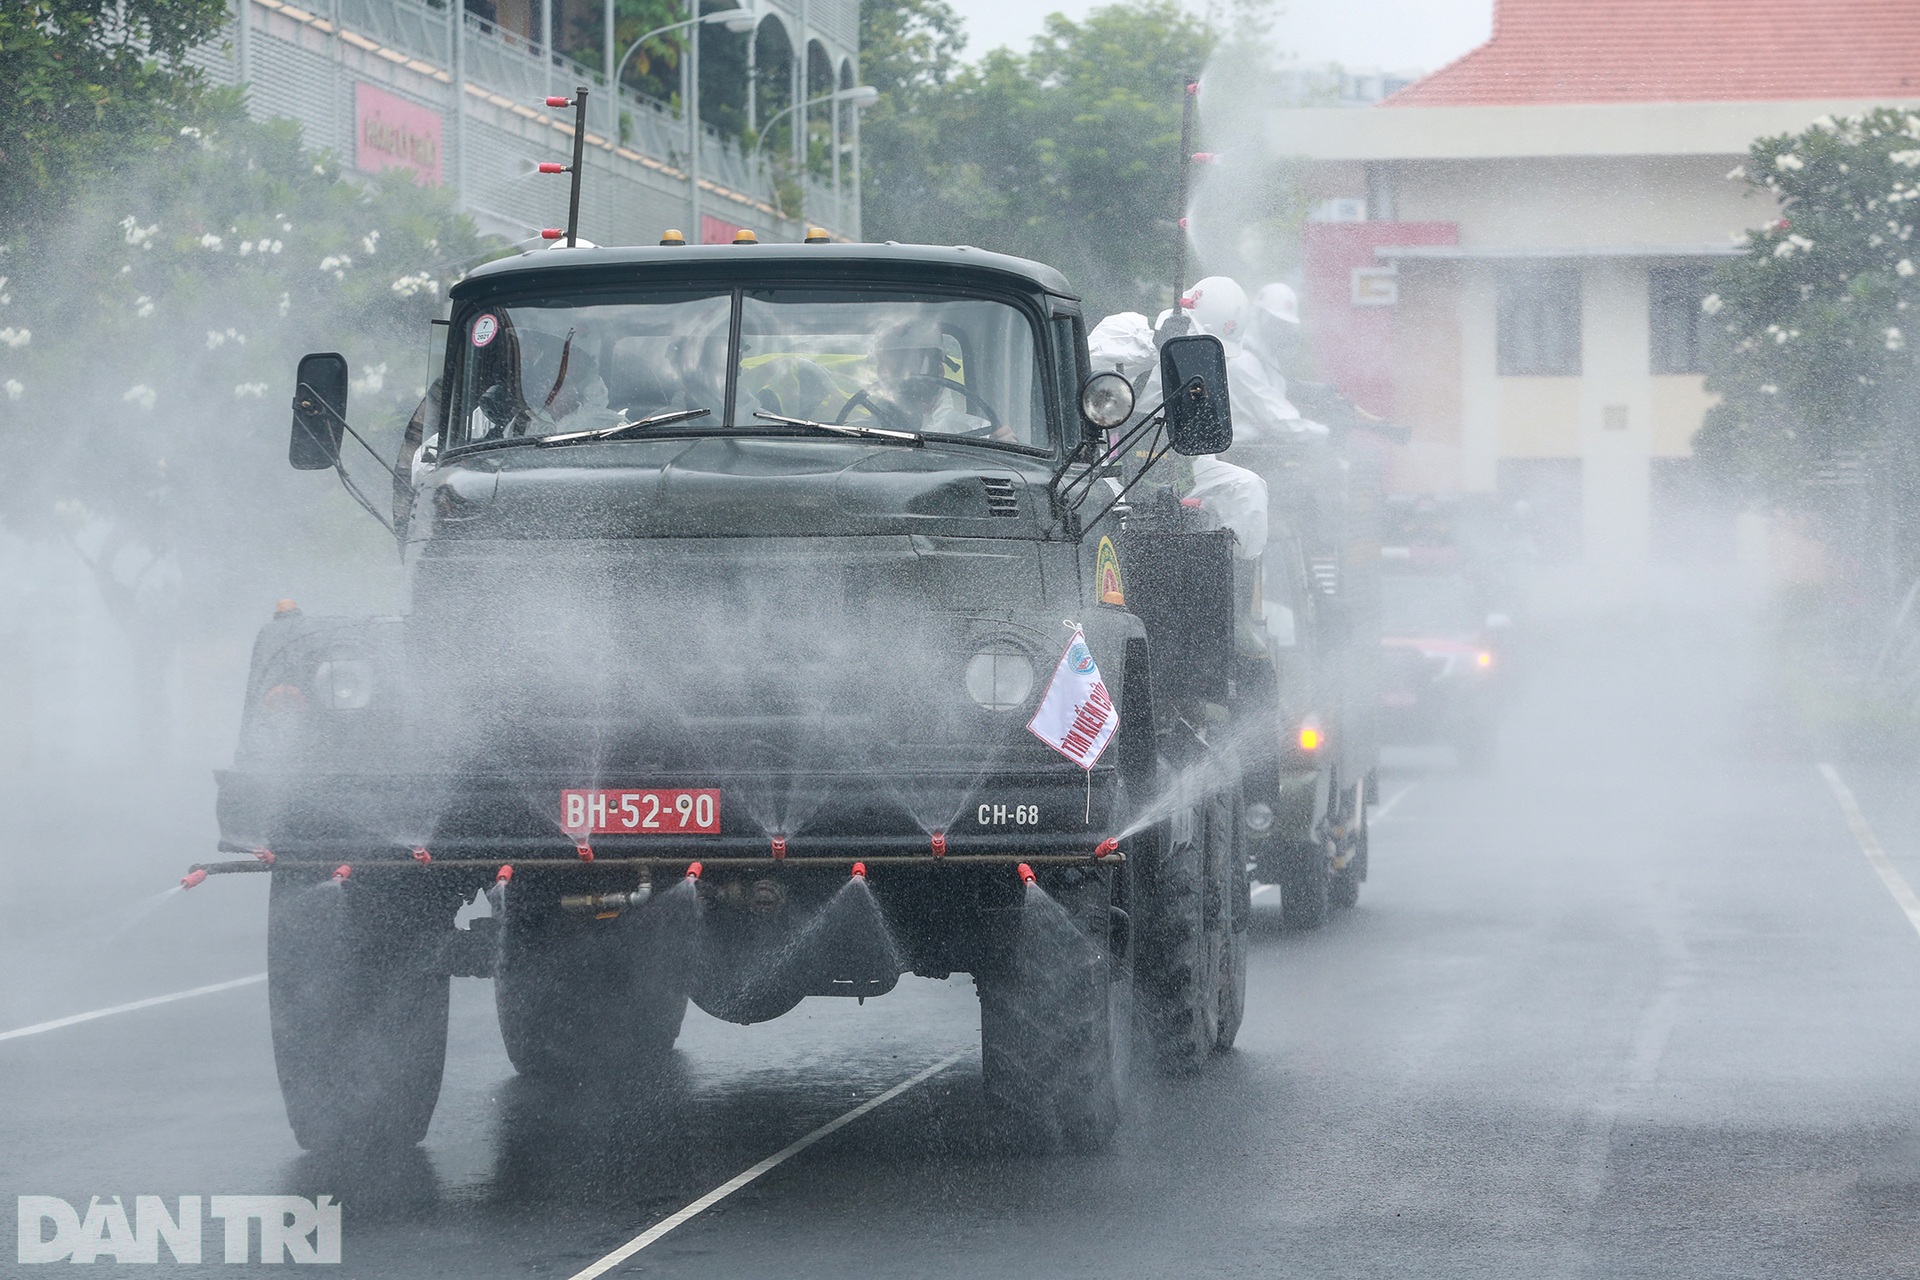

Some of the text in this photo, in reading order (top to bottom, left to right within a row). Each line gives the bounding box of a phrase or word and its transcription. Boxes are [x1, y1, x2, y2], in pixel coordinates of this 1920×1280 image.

[483, 321, 489, 330] 7
[1072, 701, 1109, 740] KIẾM
[1060, 729, 1092, 758] TÌM
[566, 794, 714, 828] BH-52-90
[978, 804, 1039, 825] CH-68
